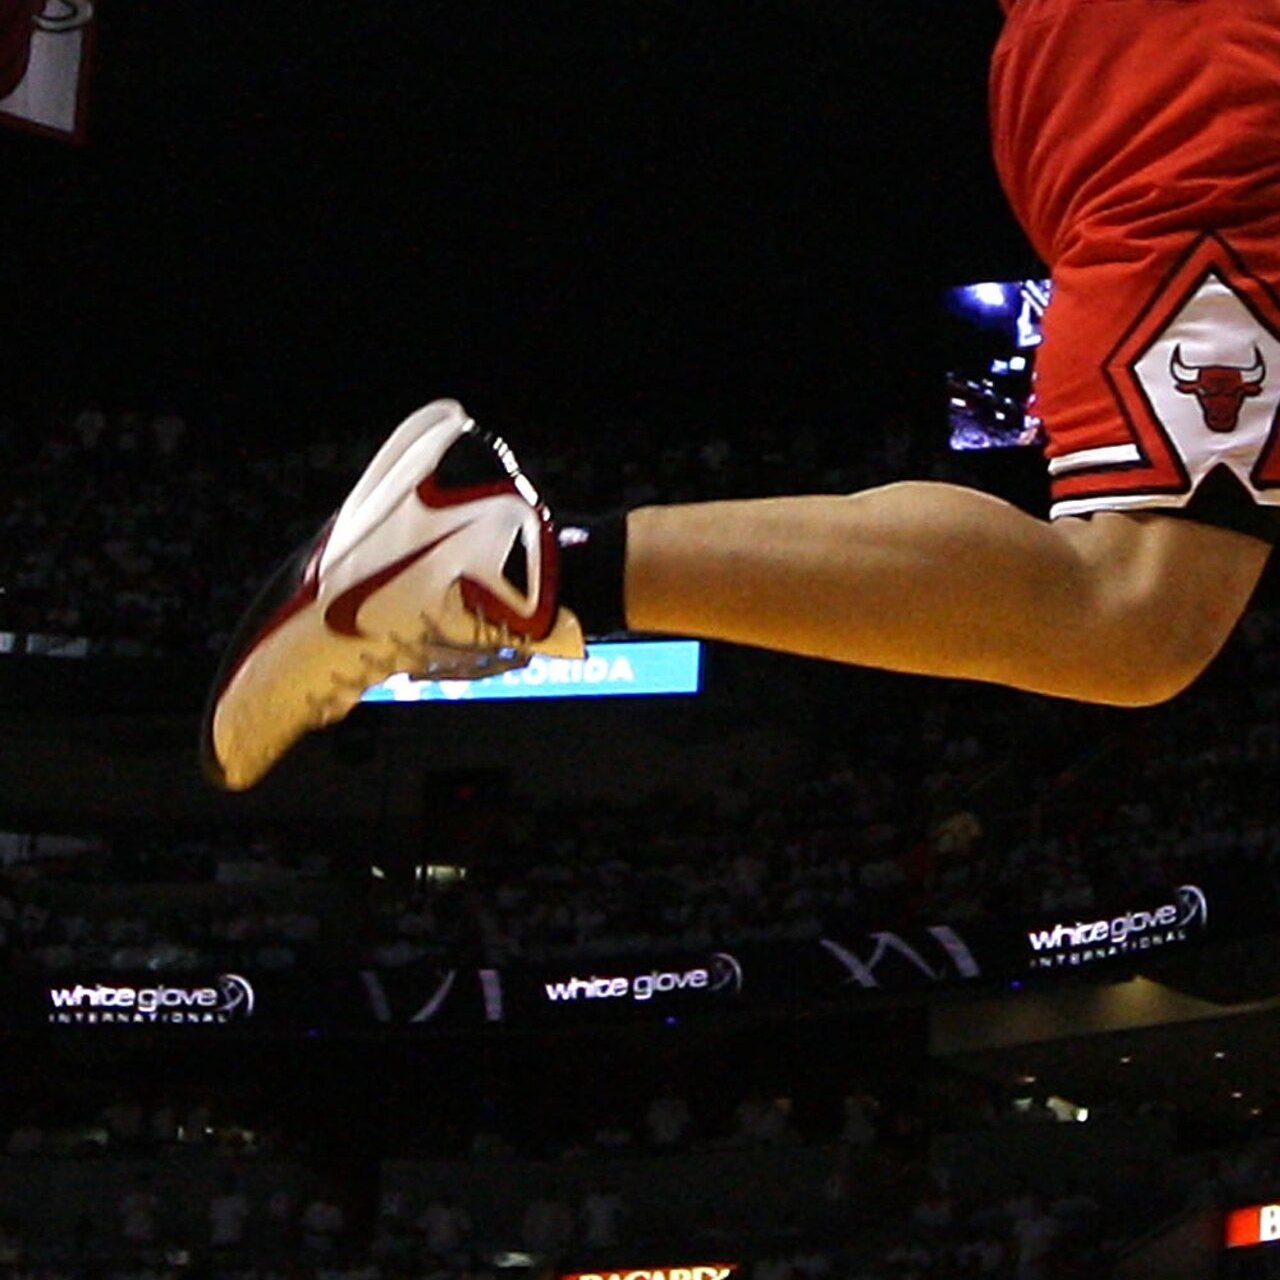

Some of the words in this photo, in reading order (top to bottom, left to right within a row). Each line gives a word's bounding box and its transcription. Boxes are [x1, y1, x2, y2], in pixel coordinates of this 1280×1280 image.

[1029, 923, 1109, 951] white
[1110, 904, 1177, 943] glove
[50, 984, 136, 1007] white
[137, 984, 218, 1013] glove
[545, 977, 629, 1001] white
[633, 969, 708, 1000] glove
